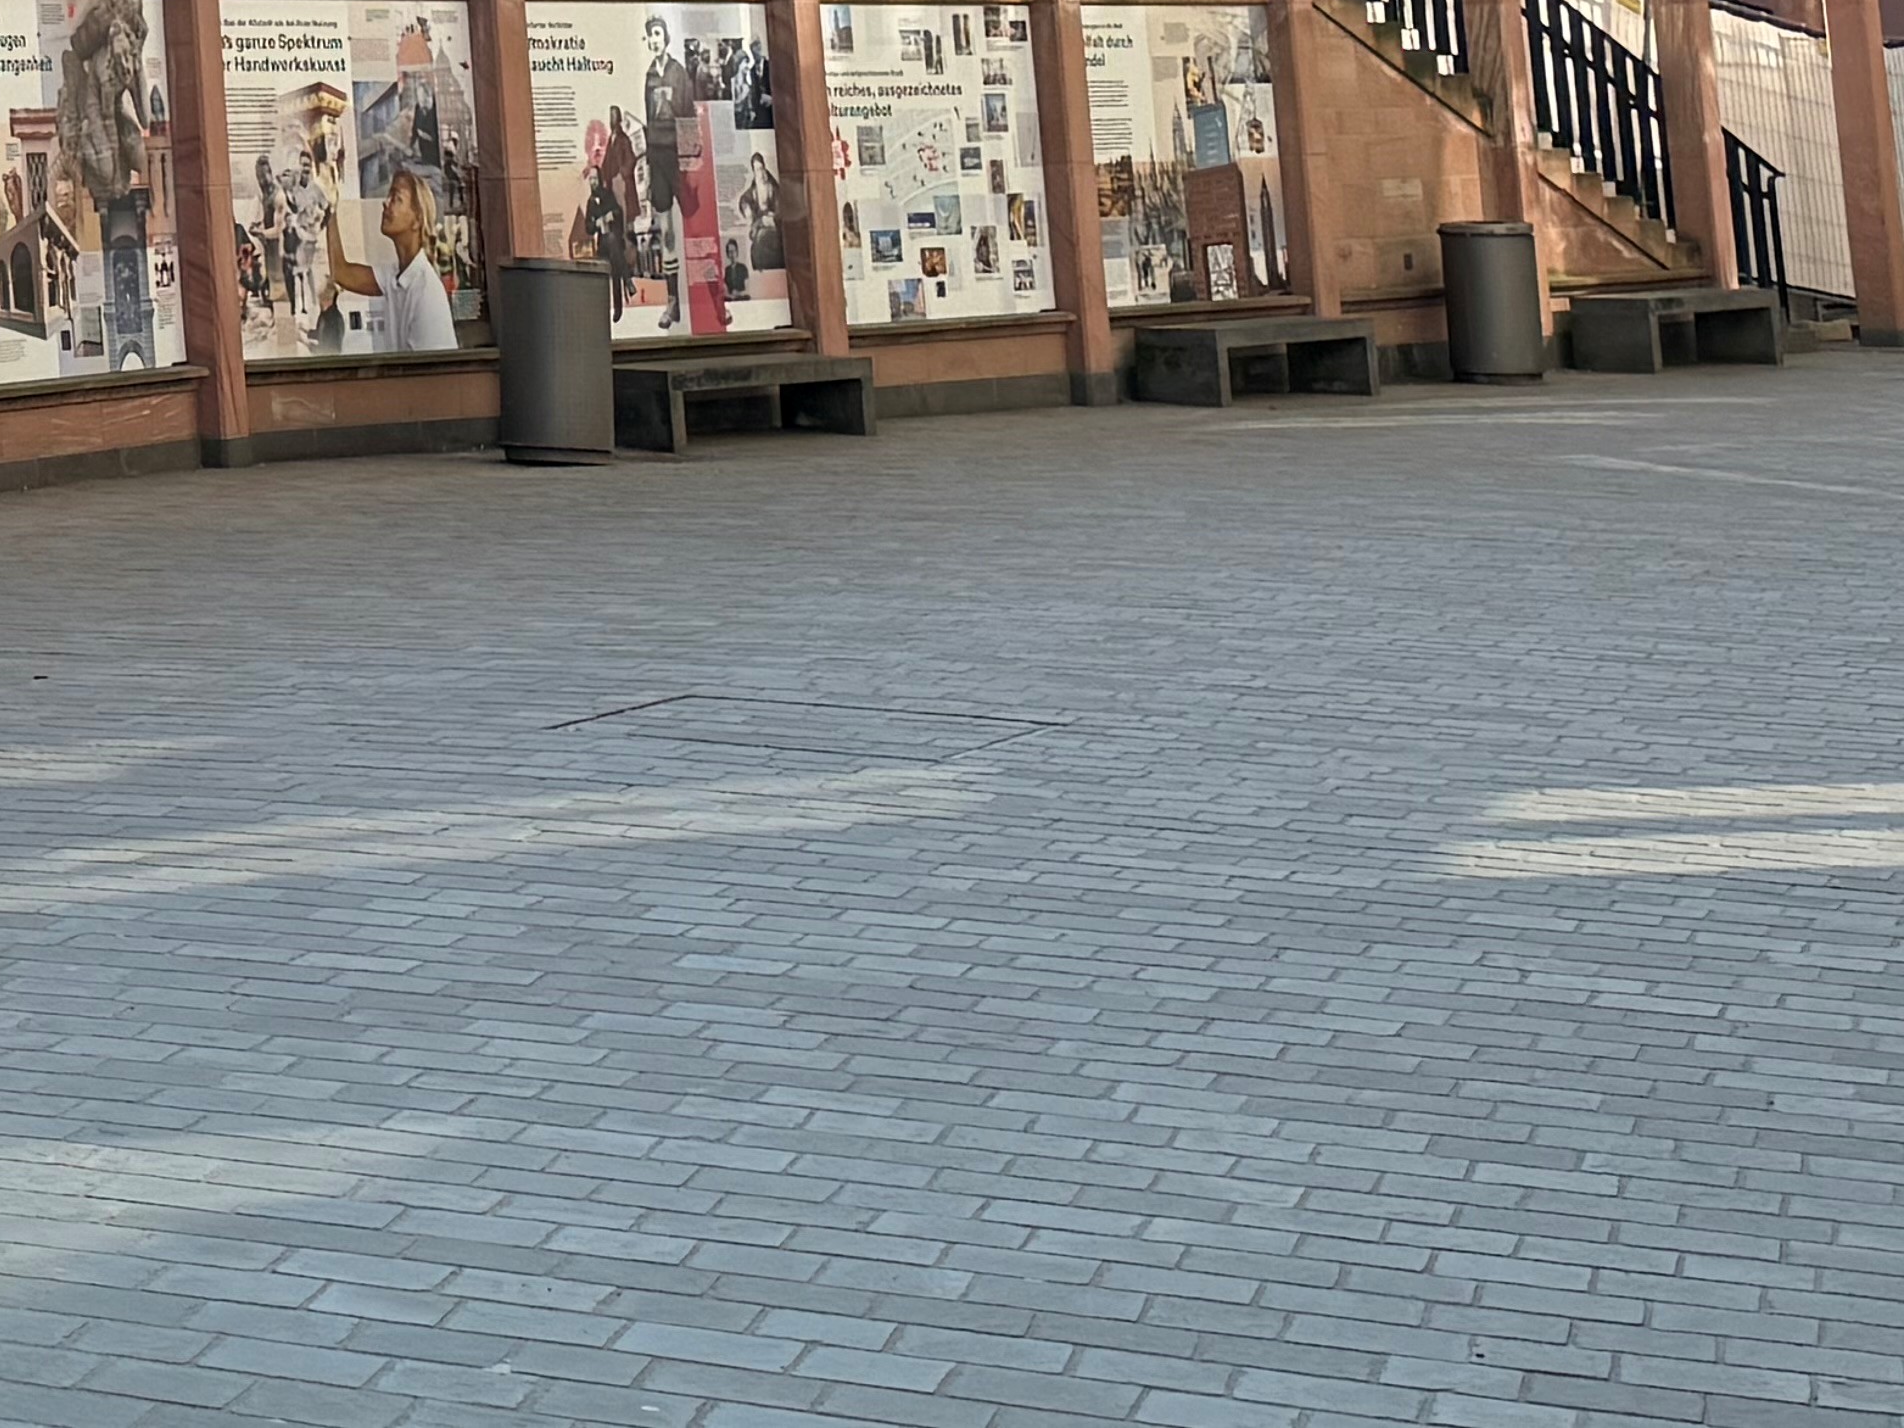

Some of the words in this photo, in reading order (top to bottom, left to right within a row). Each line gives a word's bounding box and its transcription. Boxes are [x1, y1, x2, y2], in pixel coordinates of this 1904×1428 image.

[235, 37, 276, 53] ganze
[278, 33, 343, 52] Spektrum
[235, 56, 346, 72] Handwerkskunst
[567, 55, 614, 75] Haltung
[834, 82, 876, 99] reiches,
[878, 82, 963, 99] ausgezeichnetes
